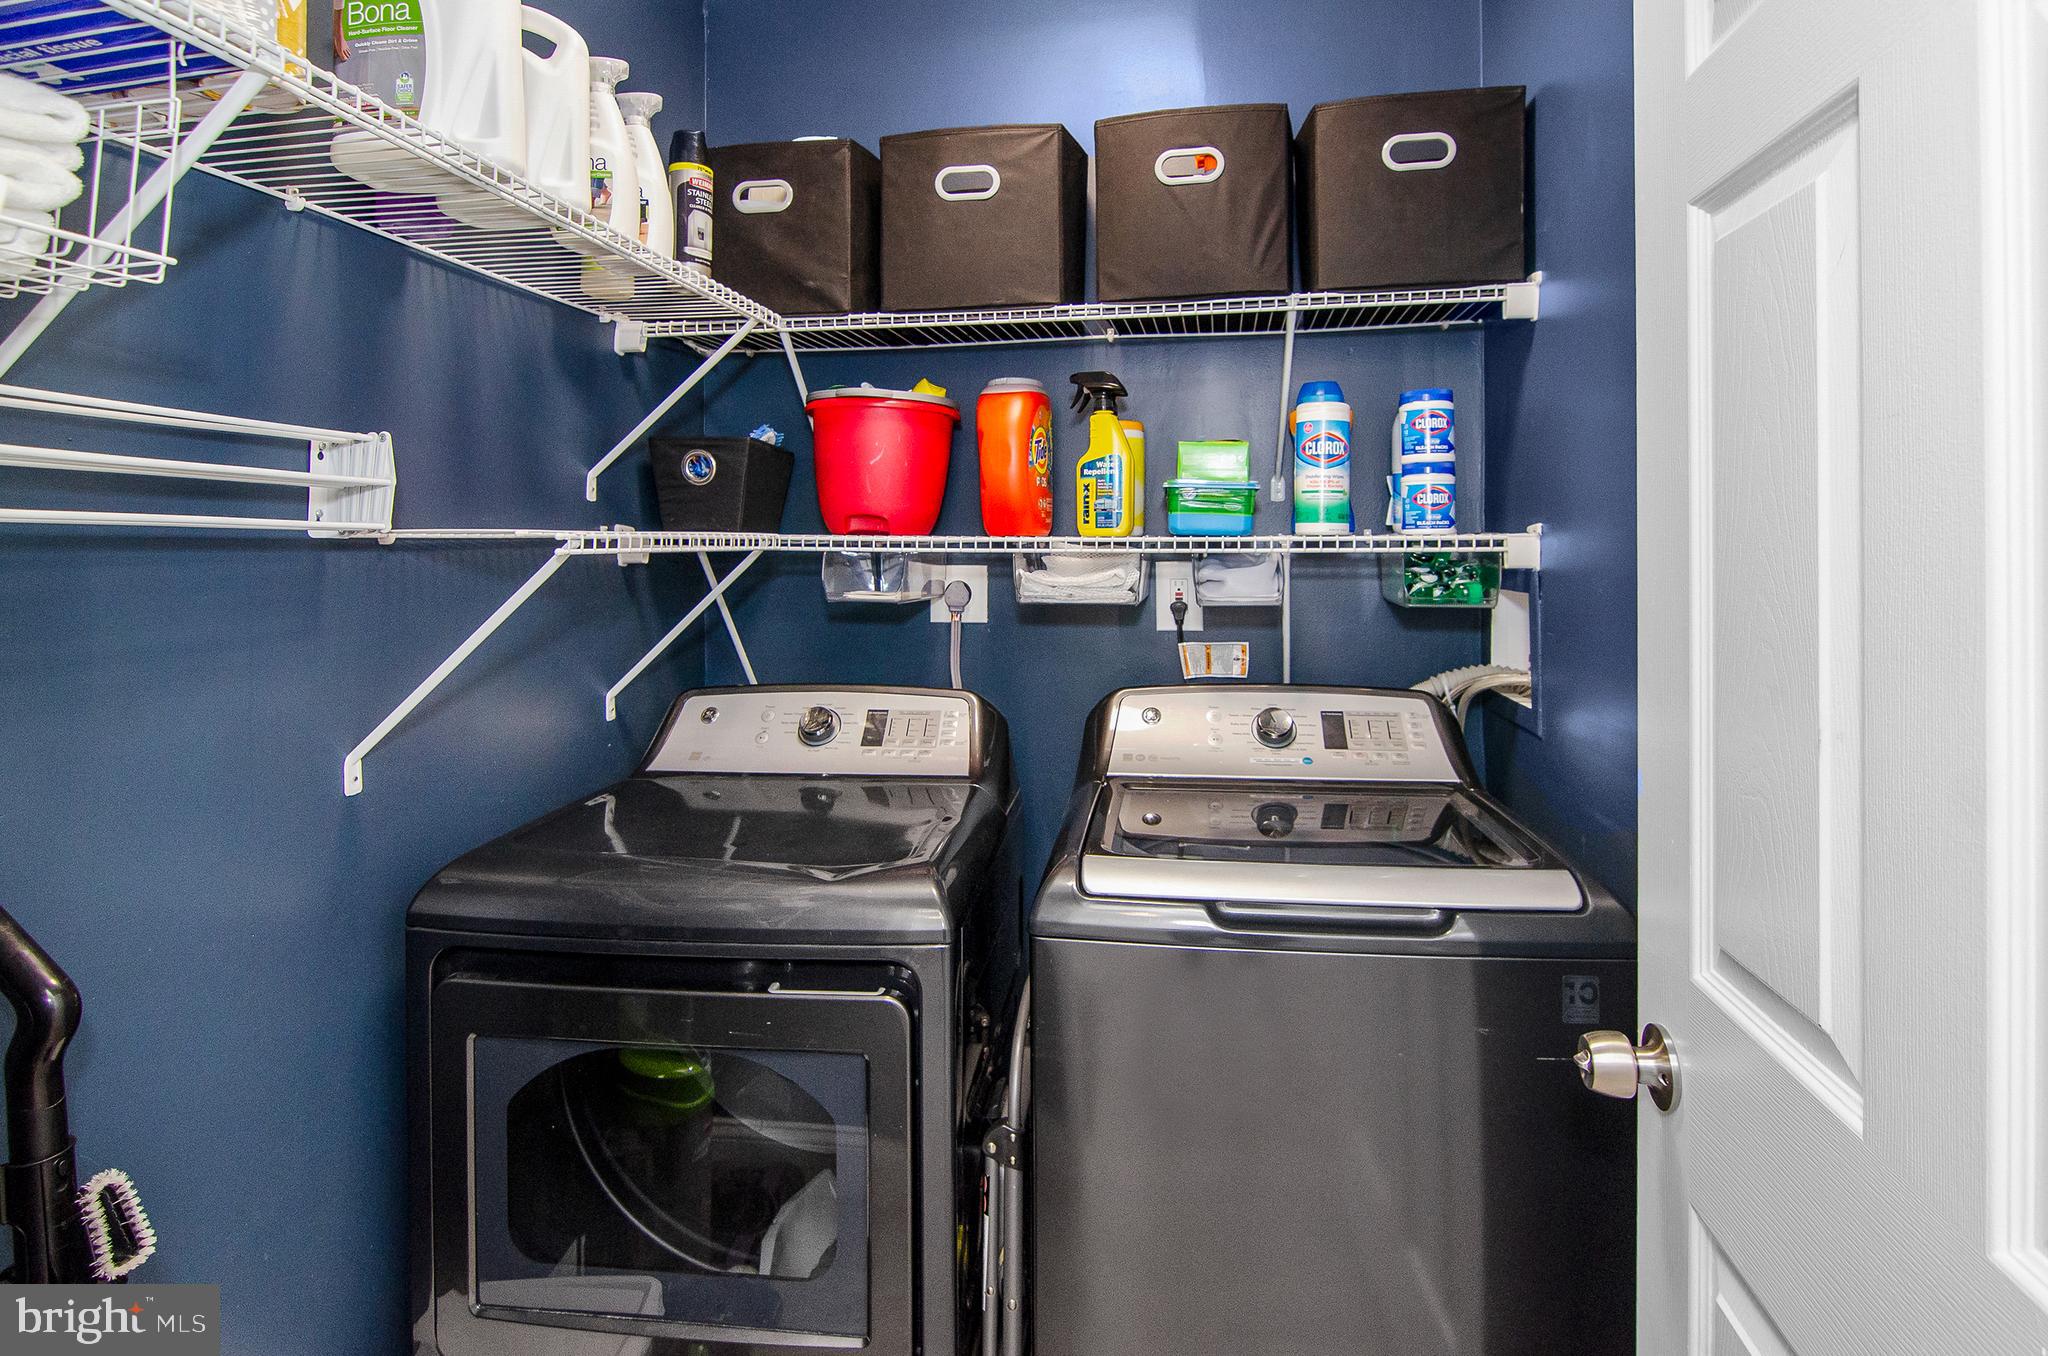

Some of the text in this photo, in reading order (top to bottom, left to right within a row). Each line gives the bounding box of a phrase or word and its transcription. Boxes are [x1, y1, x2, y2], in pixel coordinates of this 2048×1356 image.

[348, 1, 411, 26] Bona
[348, 28, 380, 37] Hard-Surface
[36, 38, 103, 54] tissue
[1415, 417, 1447, 429] CLOROX
[1305, 441, 1345, 455] CLOROX
[1083, 467, 1116, 476] Repellen
[1417, 493, 1449, 504] CLOROX
